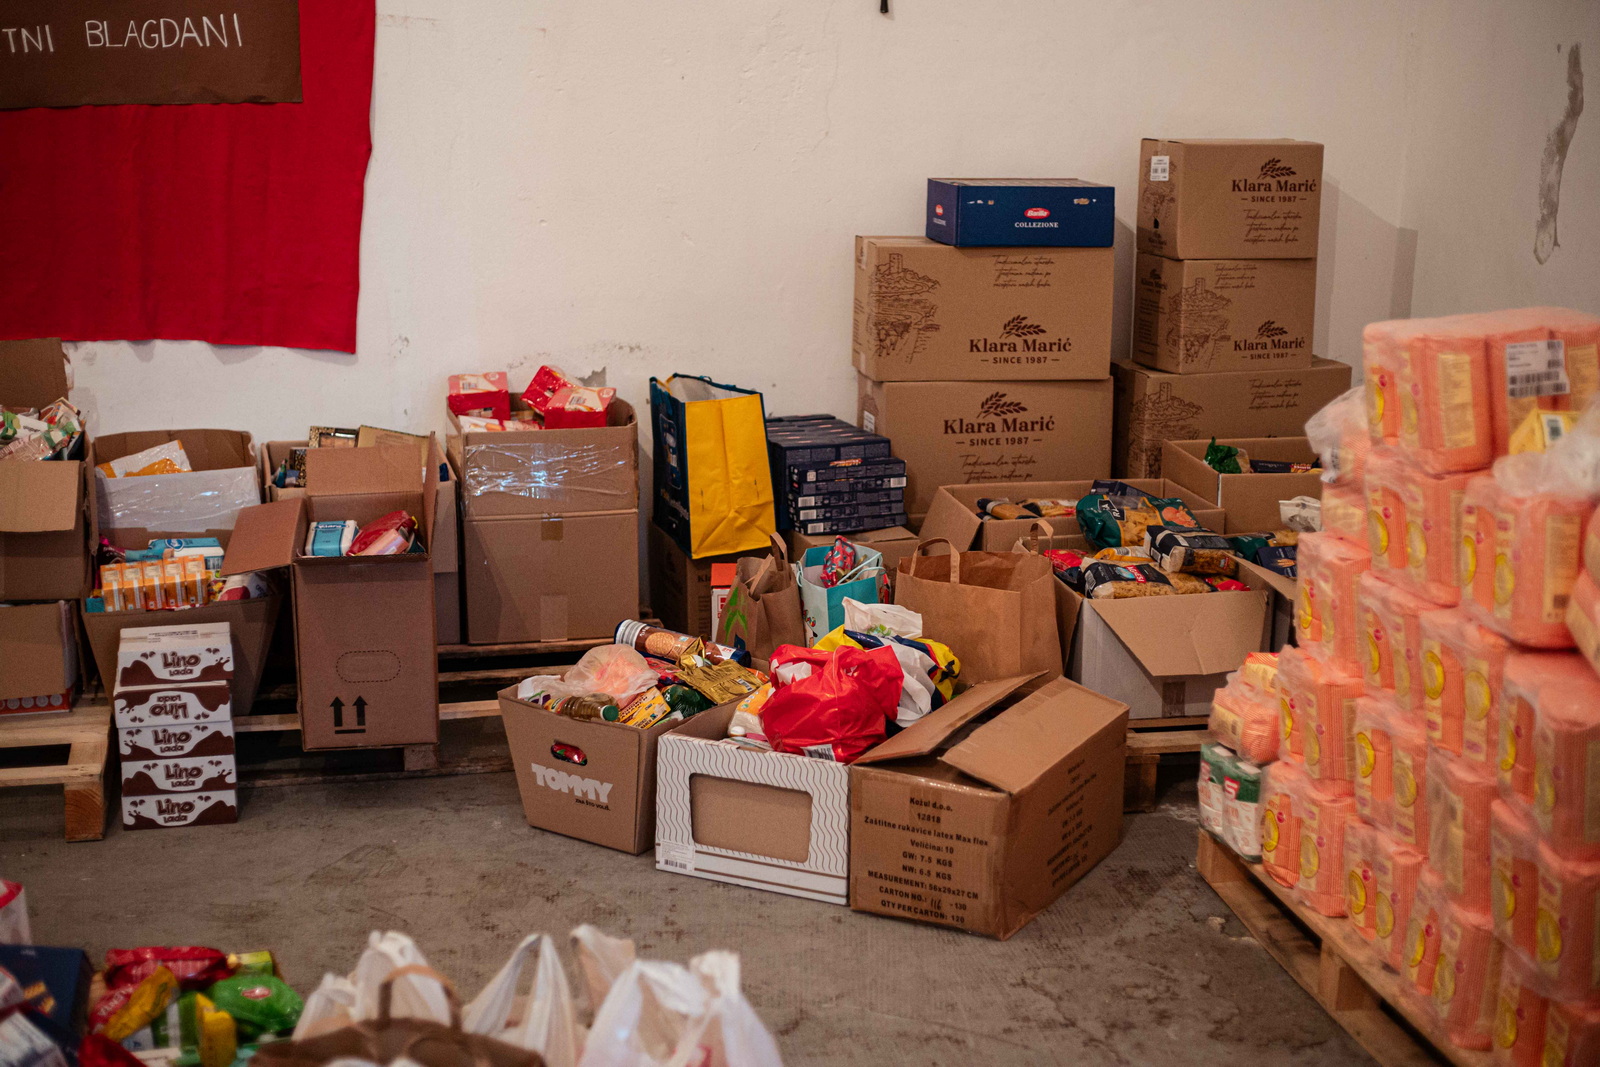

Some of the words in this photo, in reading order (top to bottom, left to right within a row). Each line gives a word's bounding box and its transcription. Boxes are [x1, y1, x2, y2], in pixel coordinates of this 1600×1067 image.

[0, 24, 54, 53] TNI
[85, 12, 242, 49] BLAGDANI
[1231, 178, 1272, 192] Klara
[1275, 178, 1317, 192] Marić
[1251, 195, 1276, 203] SINCE
[1278, 195, 1297, 203] 1987
[1014, 221, 1059, 229] COLLEZIONE
[969, 338, 1017, 353] Klara
[1022, 337, 1072, 353] Marić
[1233, 339, 1268, 351] Klara
[1271, 337, 1306, 350] Marić
[992, 356, 1022, 365] SINCE
[1025, 356, 1048, 364] 1987
[1250, 352, 1271, 360] SINCE
[943, 418, 997, 435] Klara
[1001, 415, 1055, 433] Marić
[969, 437, 1001, 446] SINCE
[1005, 436, 1029, 446] 1987
[162, 651, 202, 669] Lino
[149, 702, 189, 720] Lino
[152, 728, 192, 746] Lino
[164, 763, 203, 780] Lino
[531, 762, 613, 804] TOMMY
[156, 798, 196, 816] Lino
[932, 801, 953, 812] d.o.o.
[864, 815, 897, 829] Zaštitne
[898, 824, 932, 836] rukavice
[933, 829, 954, 841] latex
[955, 833, 971, 843] Max
[973, 836, 989, 846] flex
[910, 838, 944, 853] Veličina:
[945, 846, 954, 855] 10
[902, 851, 918, 862] GW:
[919, 854, 933, 864] 7.5
[936, 857, 953, 868] KGS
[902, 864, 918, 874] NW:
[919, 867, 932, 877] 6.5
[935, 870, 953, 881] KGS
[867, 869, 928, 890] MEASUREMENT:
[966, 890, 979, 900] CM
[879, 886, 910, 901] CARTON
[954, 902, 967, 911] 130
[880, 899, 896, 909] QTY
[897, 903, 912, 913] PER
[913, 906, 948, 920] CARTON:
[951, 914, 965, 924] 120
